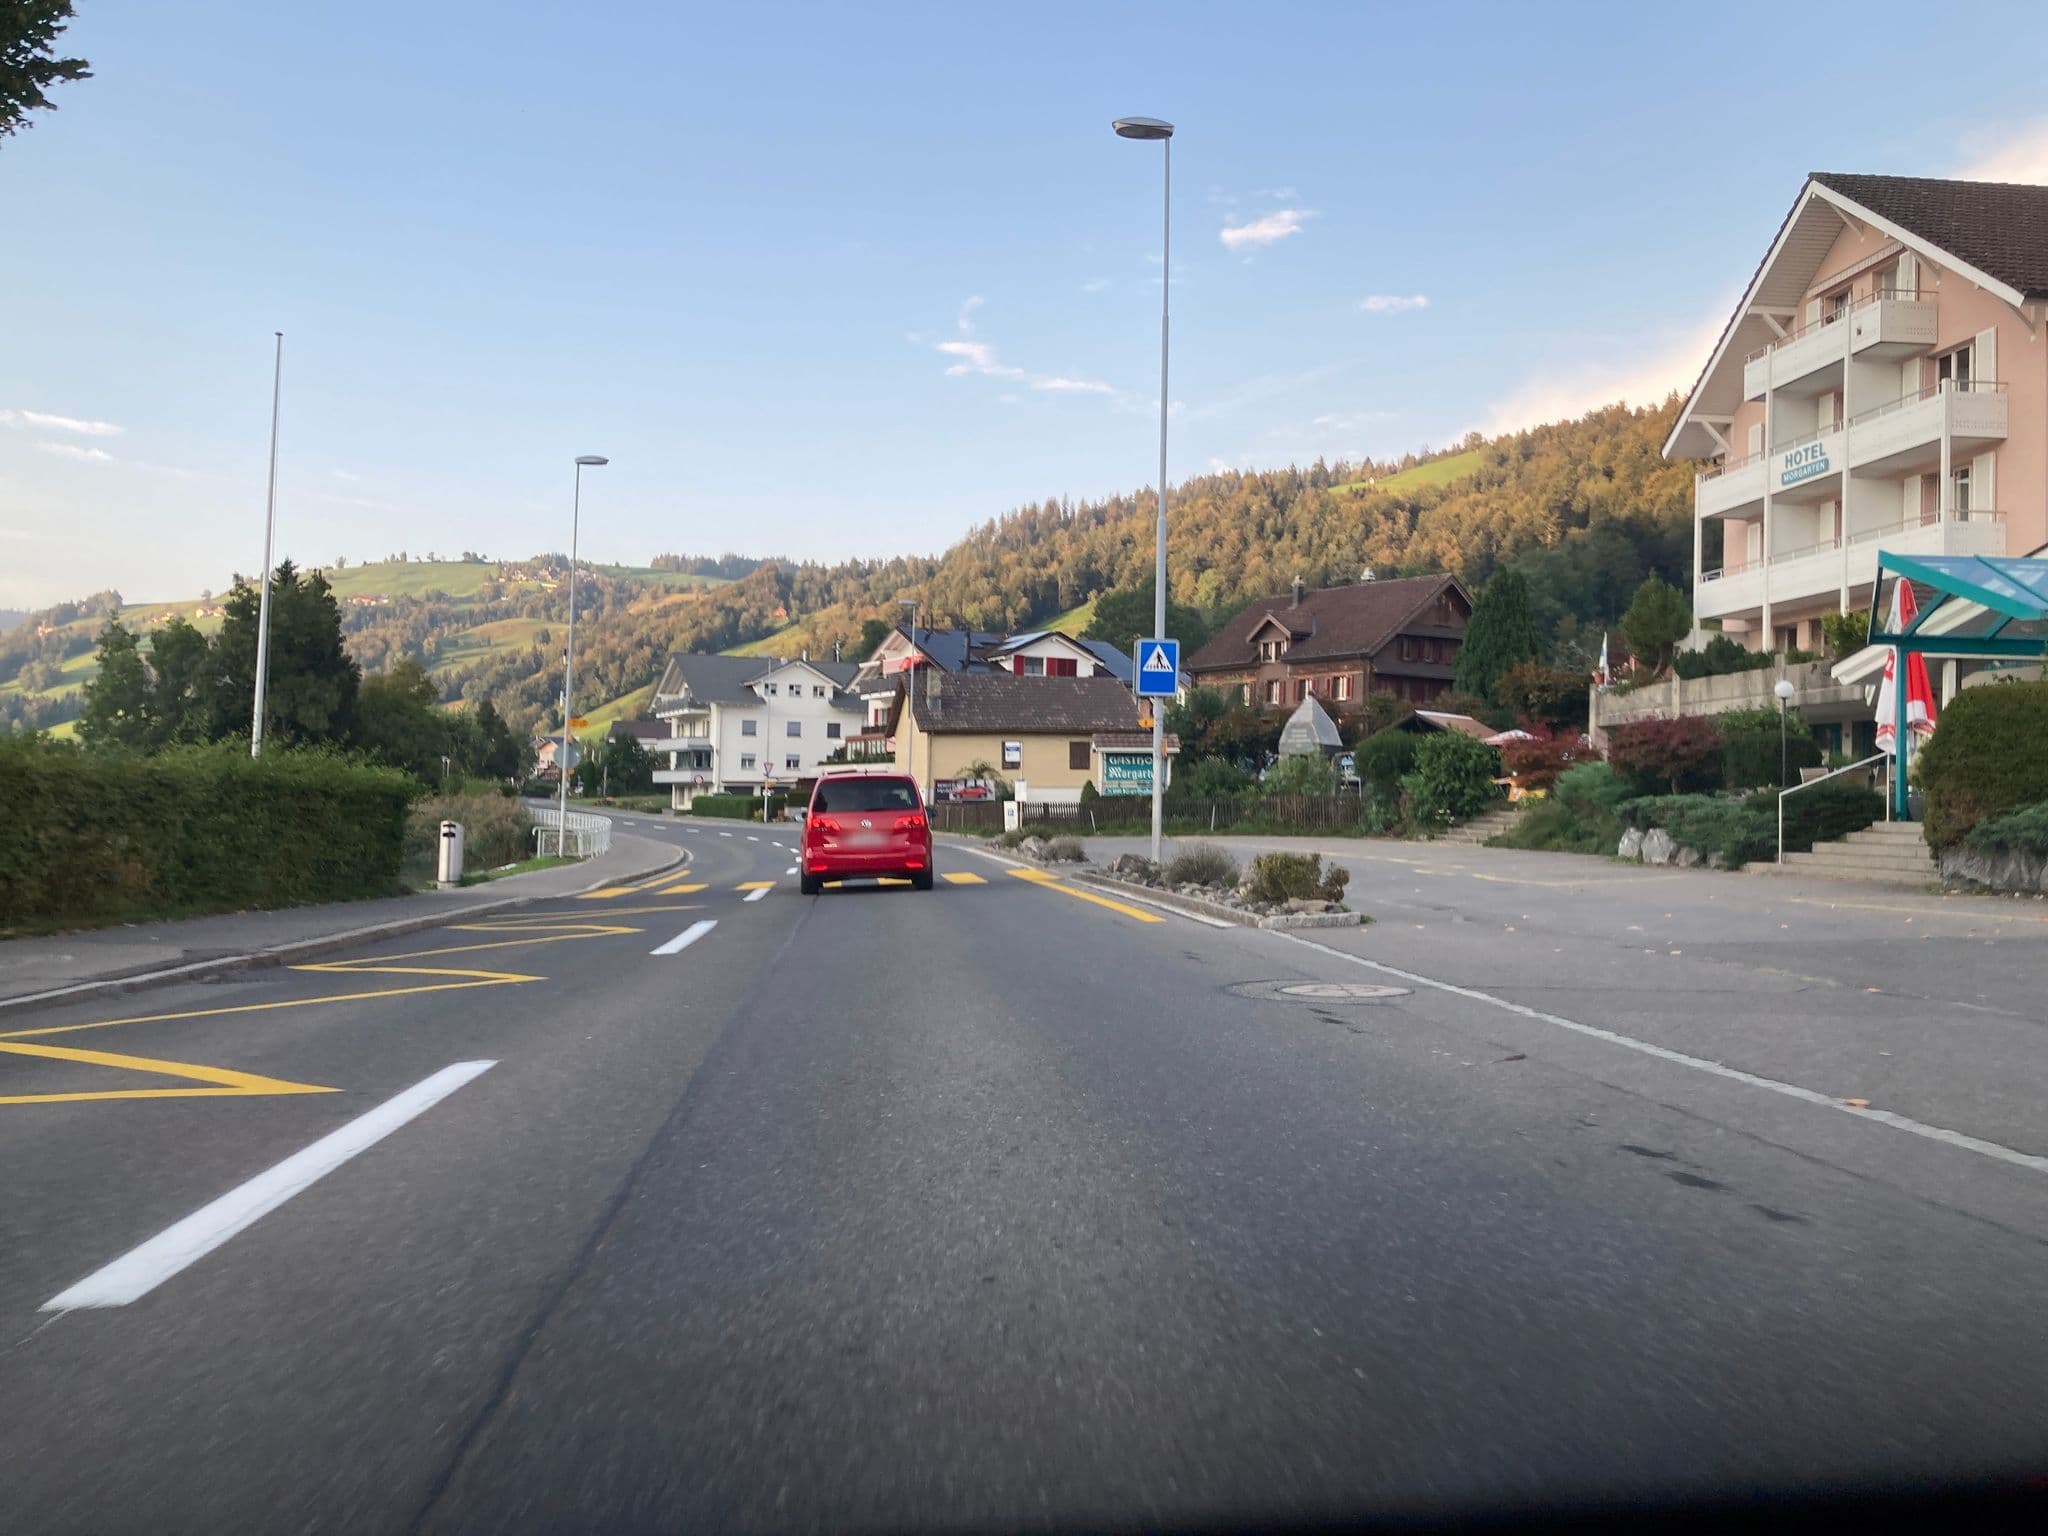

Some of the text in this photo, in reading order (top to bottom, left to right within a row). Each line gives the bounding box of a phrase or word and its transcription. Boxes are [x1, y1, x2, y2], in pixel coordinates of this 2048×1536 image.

[1785, 442, 1827, 469] HOTEL
[1783, 459, 1828, 482] MORGARTEN
[1109, 755, 1153, 765] GASTHO
[1108, 766, 1154, 780] Morgart
